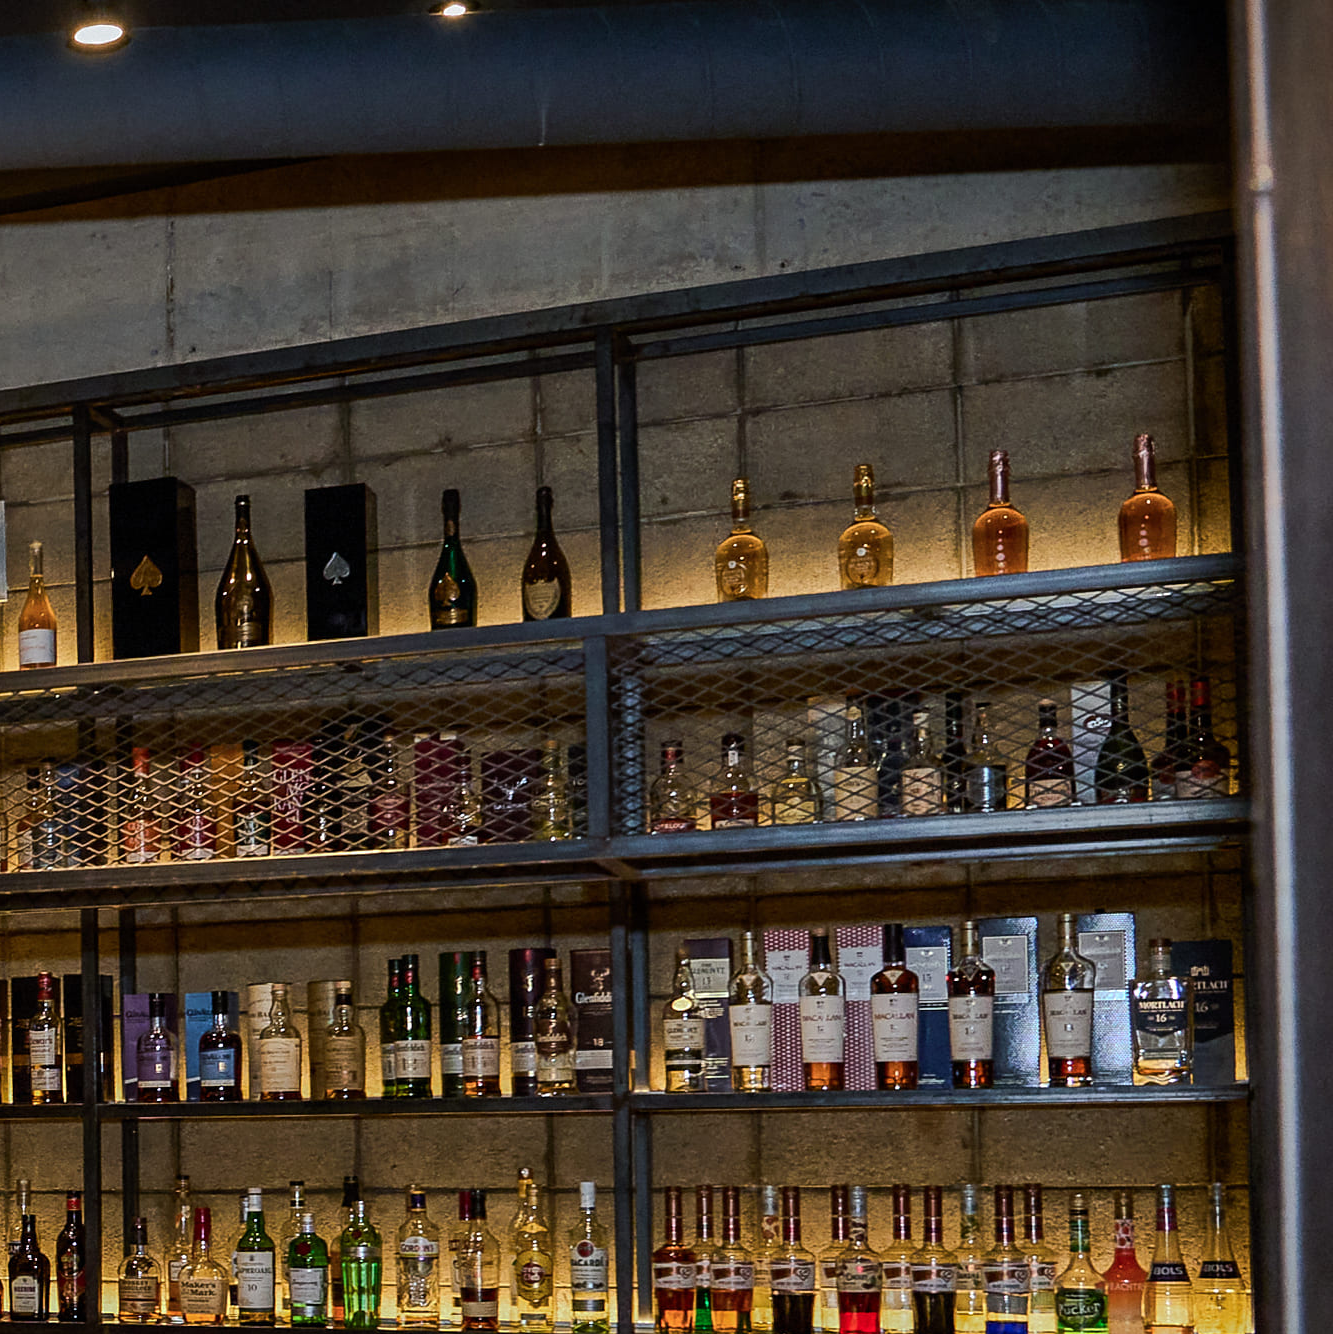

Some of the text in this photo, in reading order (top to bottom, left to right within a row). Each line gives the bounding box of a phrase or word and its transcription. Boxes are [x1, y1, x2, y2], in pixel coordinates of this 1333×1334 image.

[1138, 1001, 1184, 1010] MORTLACH
[1155, 1013, 1167, 1023] 16
[593, 1038, 604, 1046] 18
[1154, 1266, 1183, 1276] BOLS
[181, 1281, 216, 1289] Maker's
[247, 1283, 258, 1292] 10
[191, 1289, 215, 1297] Mark
